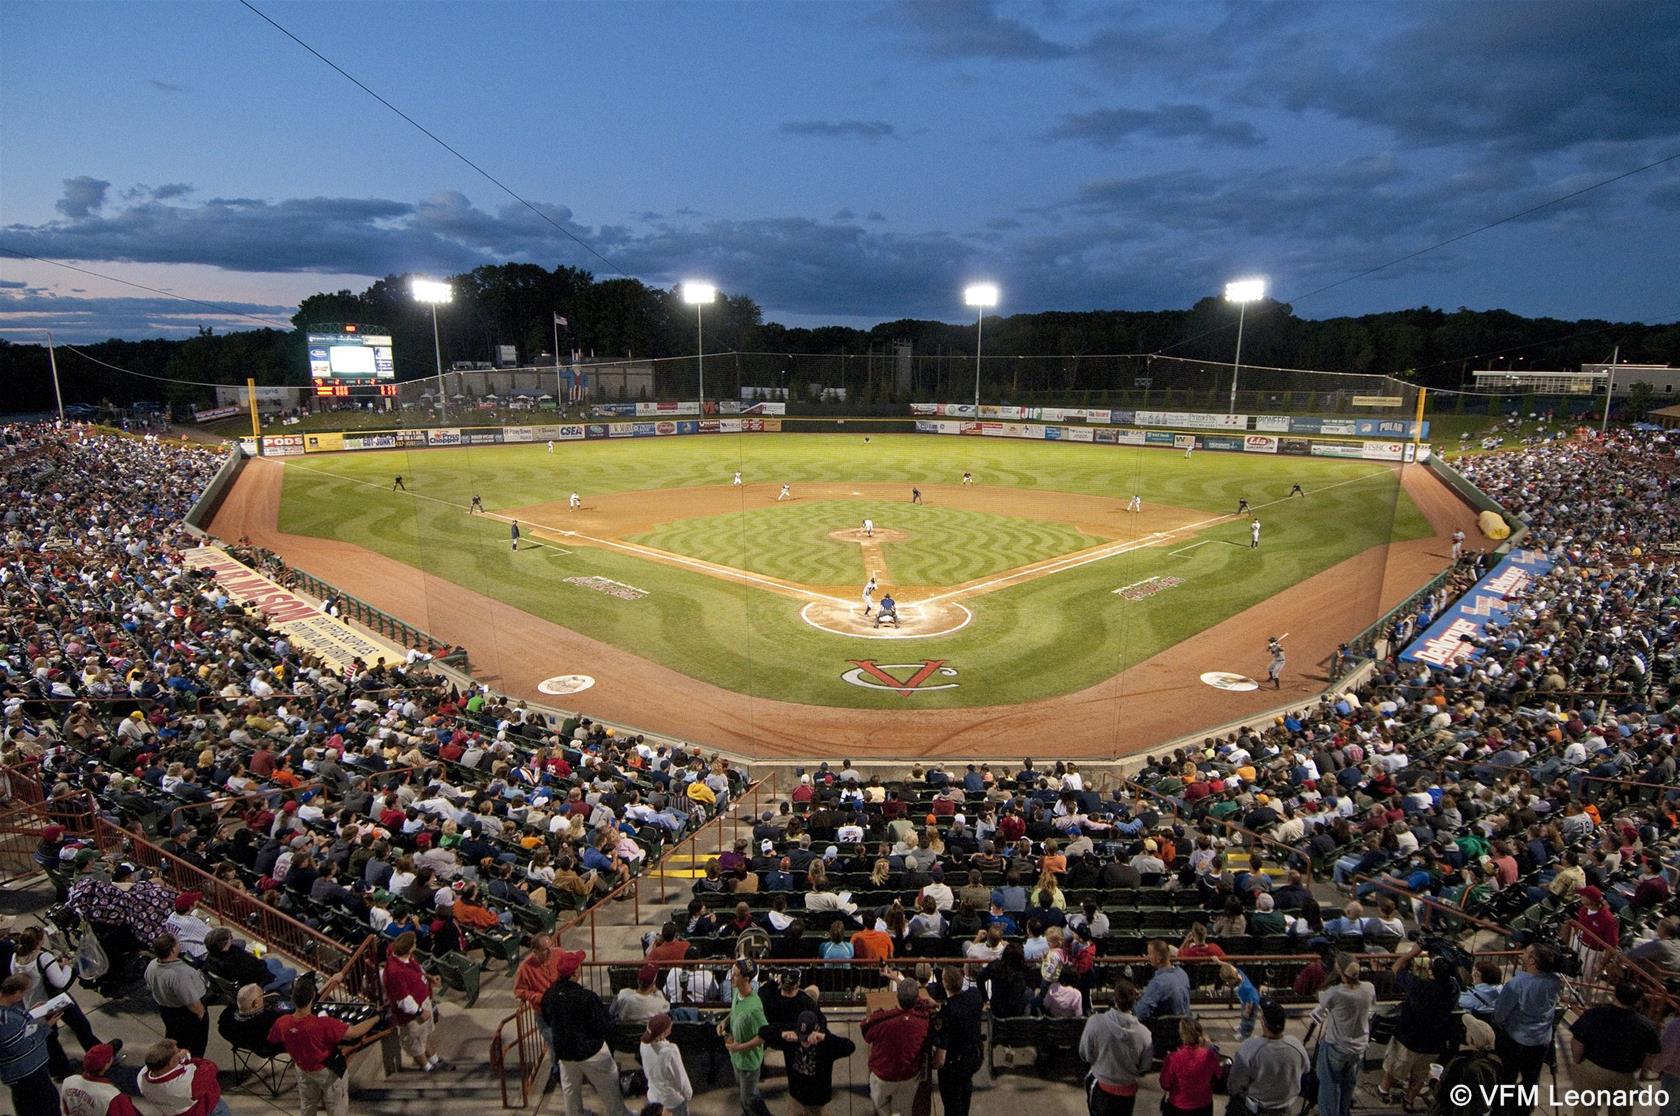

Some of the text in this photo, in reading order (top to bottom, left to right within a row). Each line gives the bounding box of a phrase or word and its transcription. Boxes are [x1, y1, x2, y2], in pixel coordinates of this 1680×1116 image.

[560, 426, 582, 436] CSEA
[1379, 422, 1404, 433] POLAR
[264, 437, 304, 446] PODS
[225, 578, 322, 623] MASON
